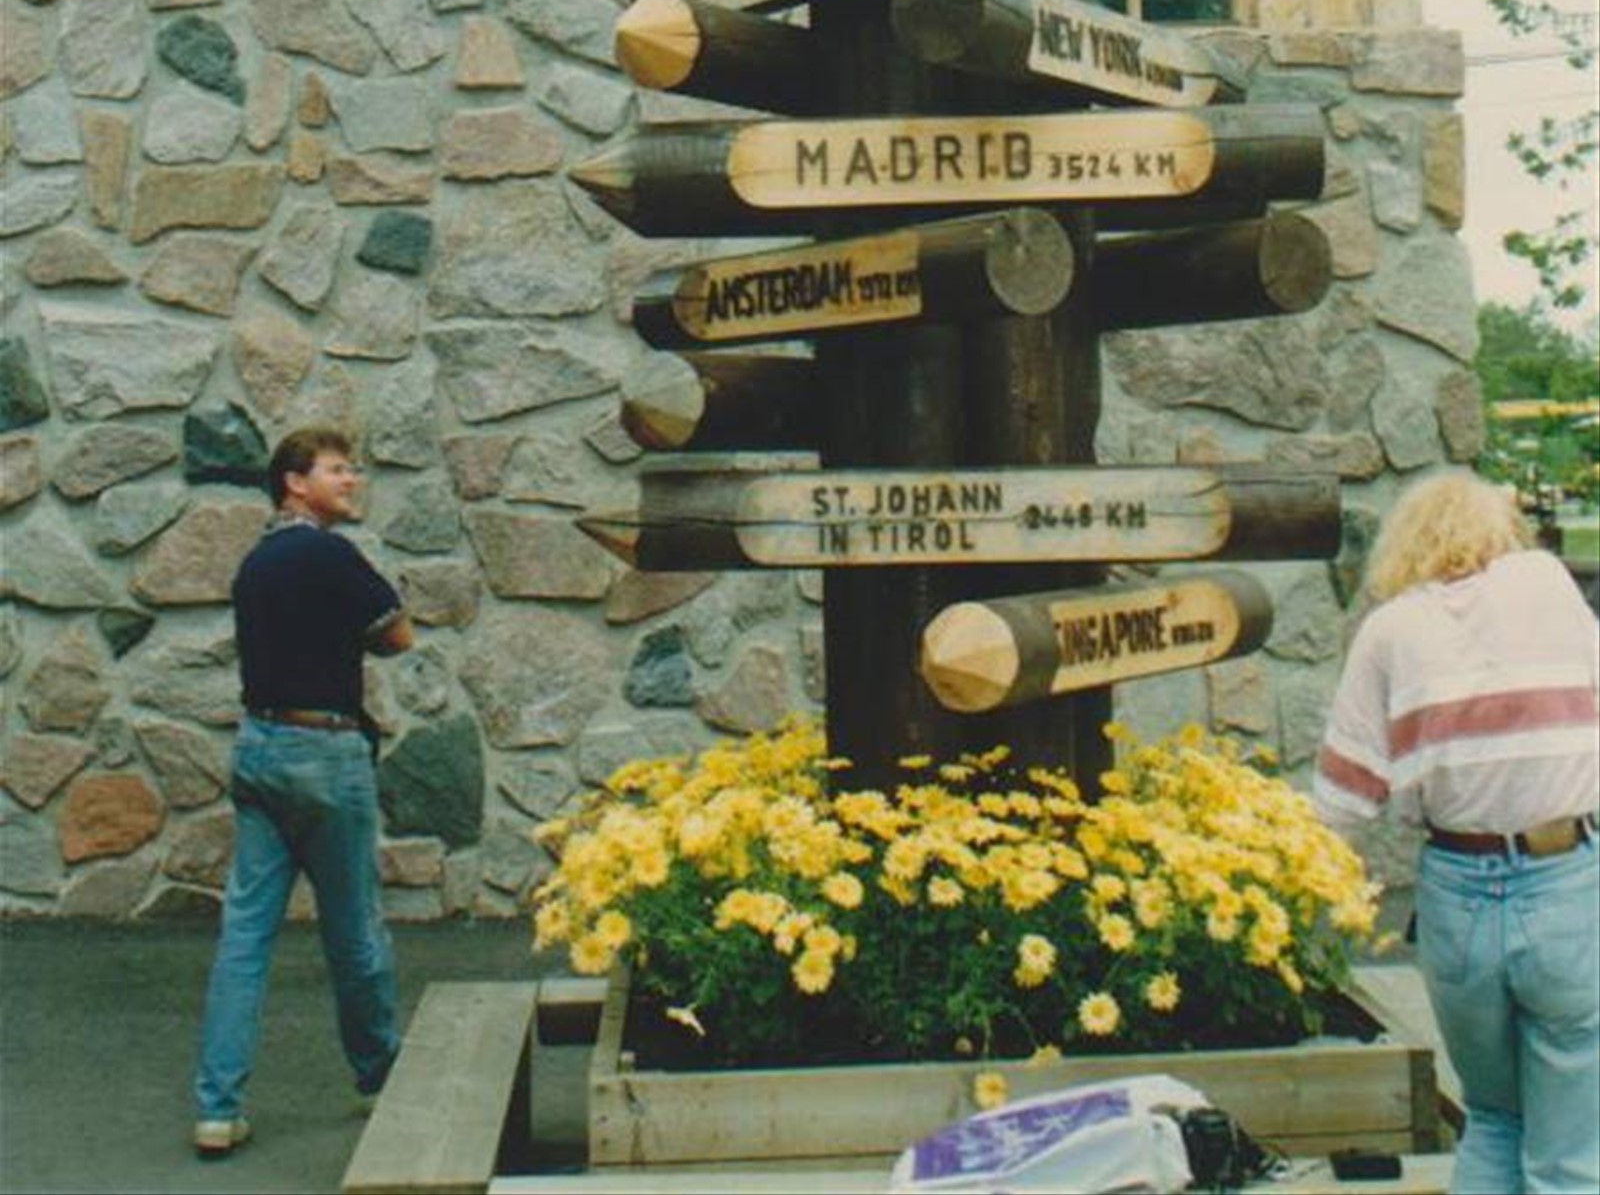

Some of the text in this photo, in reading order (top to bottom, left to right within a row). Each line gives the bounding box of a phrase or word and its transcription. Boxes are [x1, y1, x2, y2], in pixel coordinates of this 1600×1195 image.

[1038, 5, 1083, 62] NEW
[1088, 23, 1143, 78] YORK
[795, 131, 1176, 186] MADRID 3524 KM
[704, 256, 854, 325] AMSTERDAM
[811, 484, 1002, 517] ST. JOHANN
[1105, 502, 1148, 528] KM
[818, 521, 976, 553] IN TIROL
